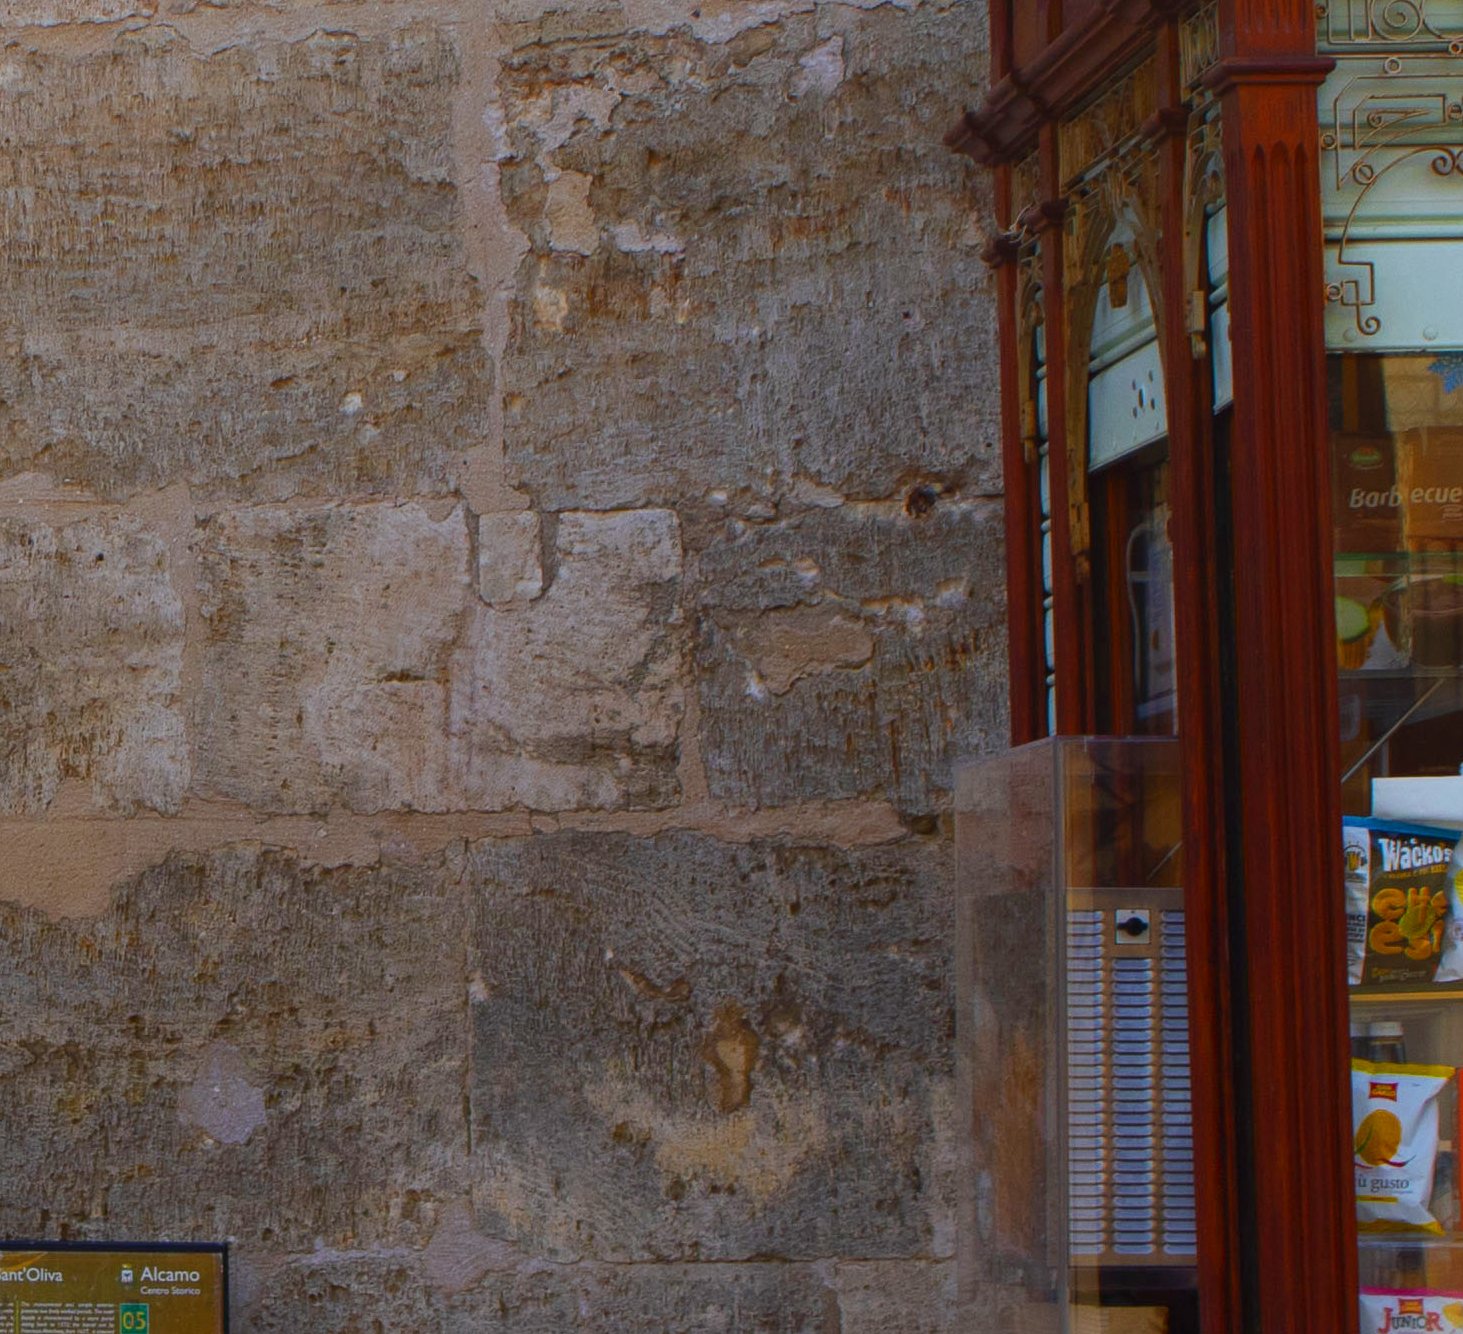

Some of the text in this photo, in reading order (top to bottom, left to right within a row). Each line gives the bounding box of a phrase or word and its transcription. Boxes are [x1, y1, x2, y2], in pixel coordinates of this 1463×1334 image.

[1370, 1177, 1410, 1193] gusto
[140, 1266, 200, 1282] Alcamo
[140, 1286, 201, 1295] Centro Storico
[122, 1311, 146, 1330] 05
